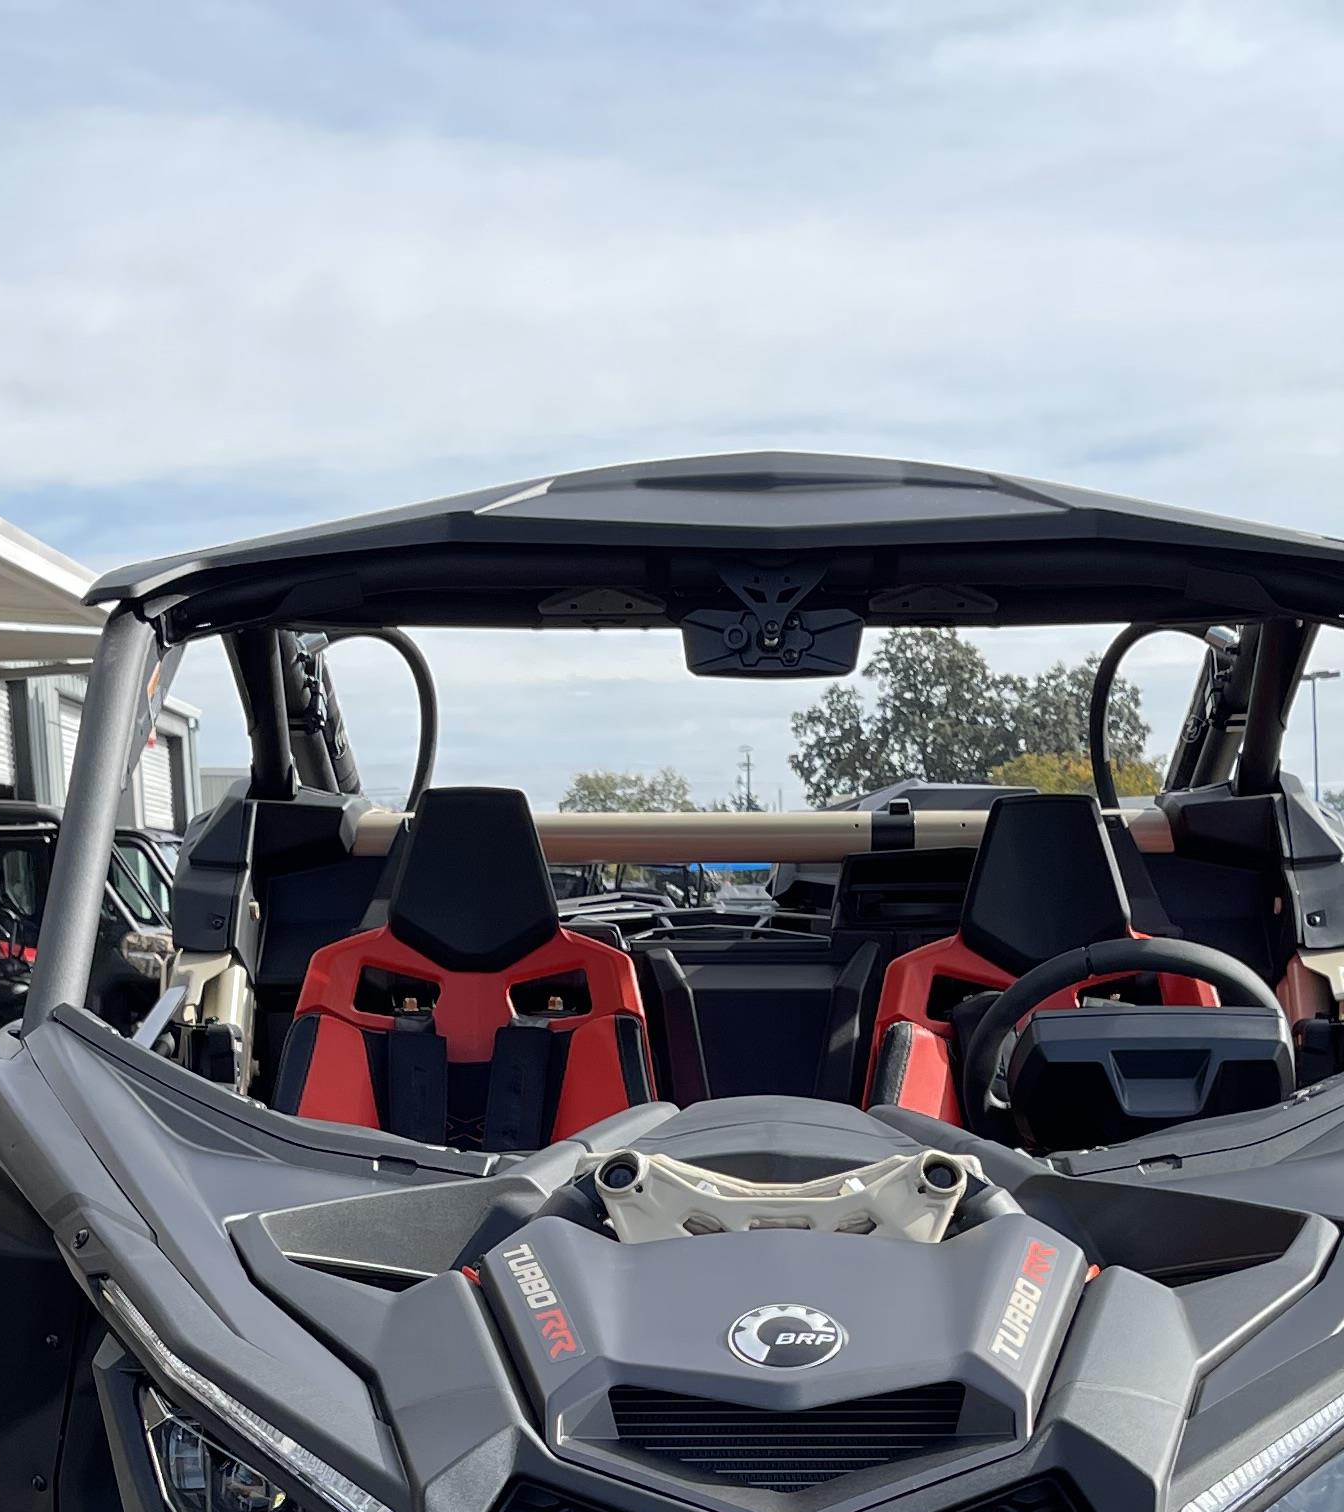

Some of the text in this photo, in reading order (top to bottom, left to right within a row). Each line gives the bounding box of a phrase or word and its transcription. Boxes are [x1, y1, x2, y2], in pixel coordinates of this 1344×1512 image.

[503, 1243, 577, 1359] TURBO RR
[774, 1332, 836, 1345] BRP
[991, 1241, 1057, 1360] TURBO RR
